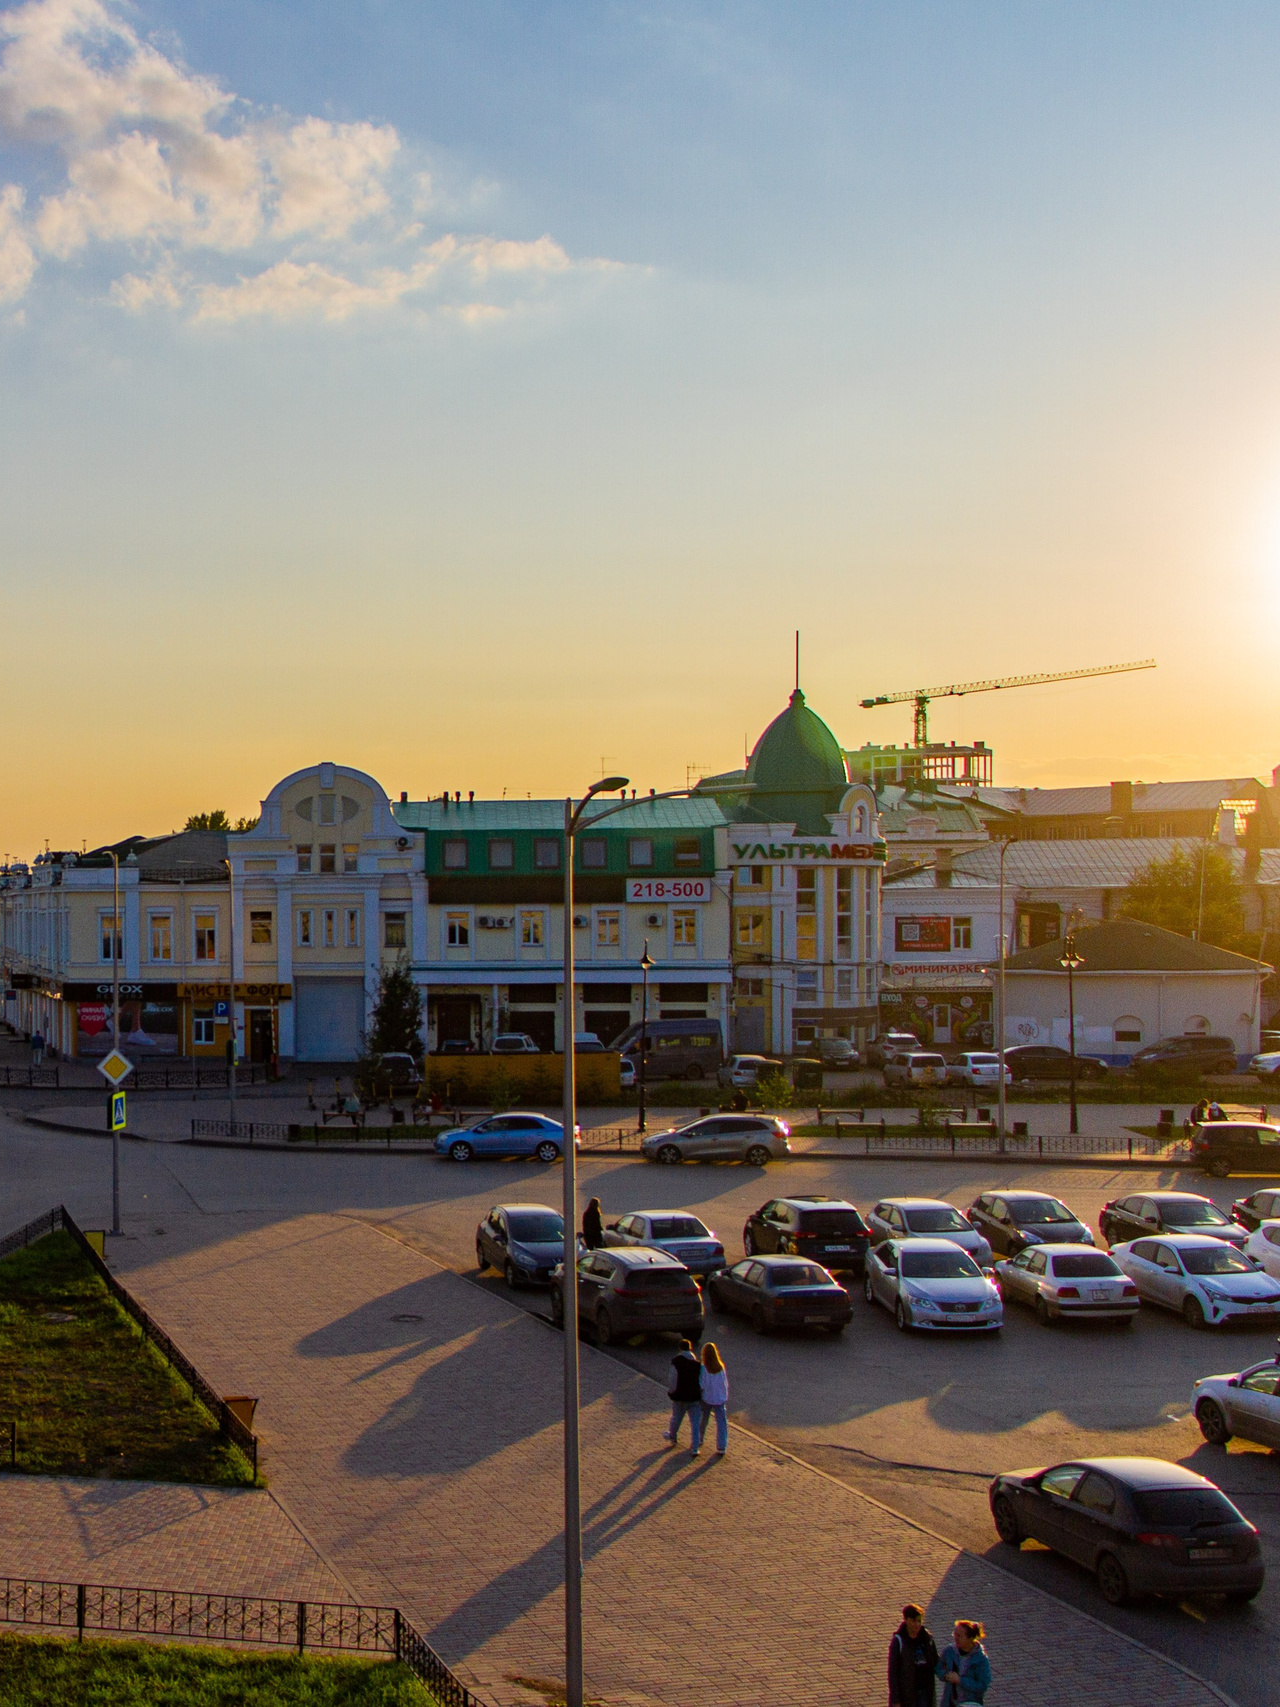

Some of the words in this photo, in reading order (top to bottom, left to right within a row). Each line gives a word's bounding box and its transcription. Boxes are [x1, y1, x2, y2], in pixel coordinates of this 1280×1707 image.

[632, 882, 704, 897] 218-500
[183, 985, 240, 996] МИСТЕР
[246, 984, 285, 996] ФОГГ
[881, 994, 902, 1002] ВХОД
[217, 1002, 226, 1014] P
